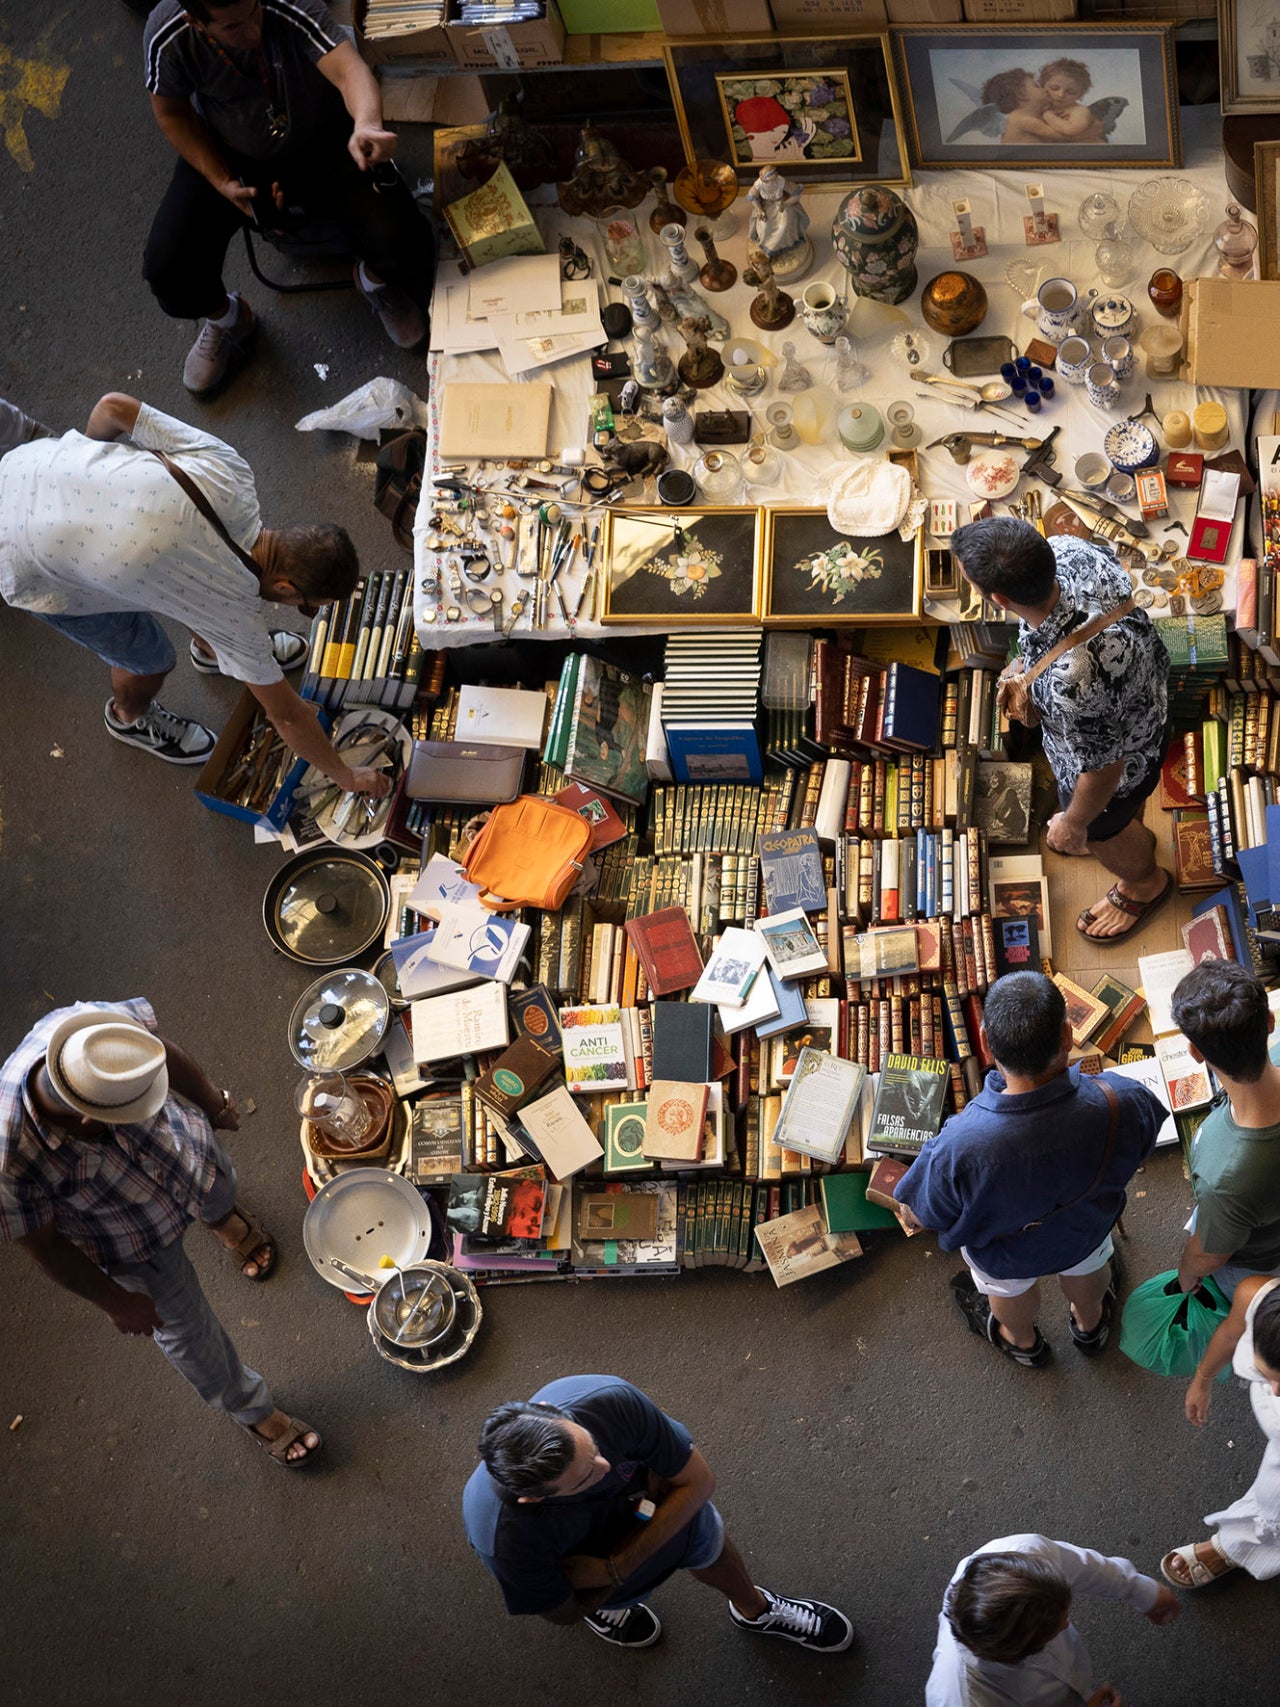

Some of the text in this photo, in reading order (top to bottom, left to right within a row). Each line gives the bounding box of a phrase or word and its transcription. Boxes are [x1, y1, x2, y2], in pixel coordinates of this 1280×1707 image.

[762, 833, 816, 852] CLEOPATRA
[472, 1008, 483, 1047] Ramiro
[579, 1036, 608, 1048] ANTI
[1128, 1047, 1145, 1055] JOHN
[569, 1045, 619, 1058] CANCER
[886, 1054, 948, 1076] DAVID ELLIS
[876, 1113, 906, 1127] FALSAS
[883, 1125, 934, 1143] APARIENCIAS
[768, 1227, 797, 1278] JASMINA
